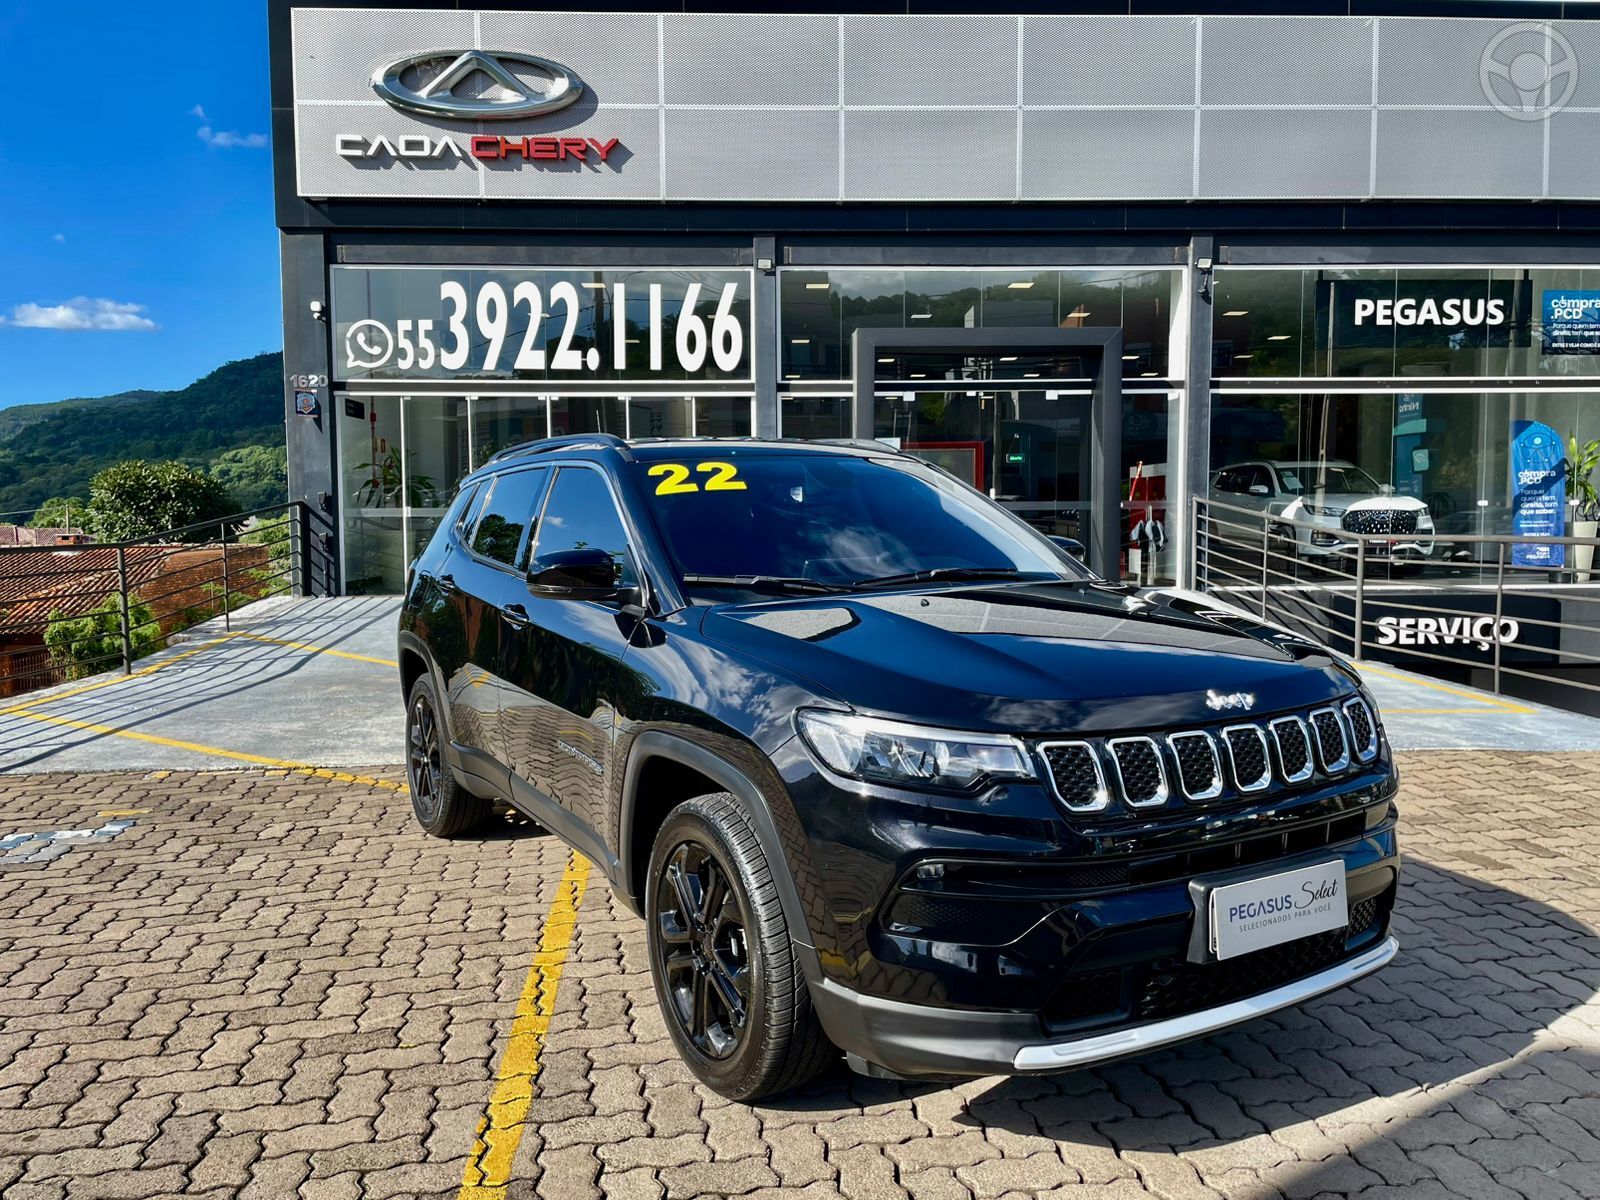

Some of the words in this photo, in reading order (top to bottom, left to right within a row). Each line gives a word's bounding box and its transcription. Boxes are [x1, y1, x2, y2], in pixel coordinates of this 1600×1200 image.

[470, 136, 619, 160] CHERY
[1354, 298, 1505, 326] PEGASUS
[290, 374, 328, 388] 1620
[647, 461, 748, 496] 22
[1376, 616, 1519, 651] SERVIÇO
[1206, 689, 1255, 710] Jeep
[1229, 894, 1292, 922] PEGASUS
[1293, 878, 1338, 909] Select
[1239, 912, 1292, 932] SELECIONADOS
[1293, 907, 1311, 918] PARA
[1314, 901, 1331, 914] VOCÊ
